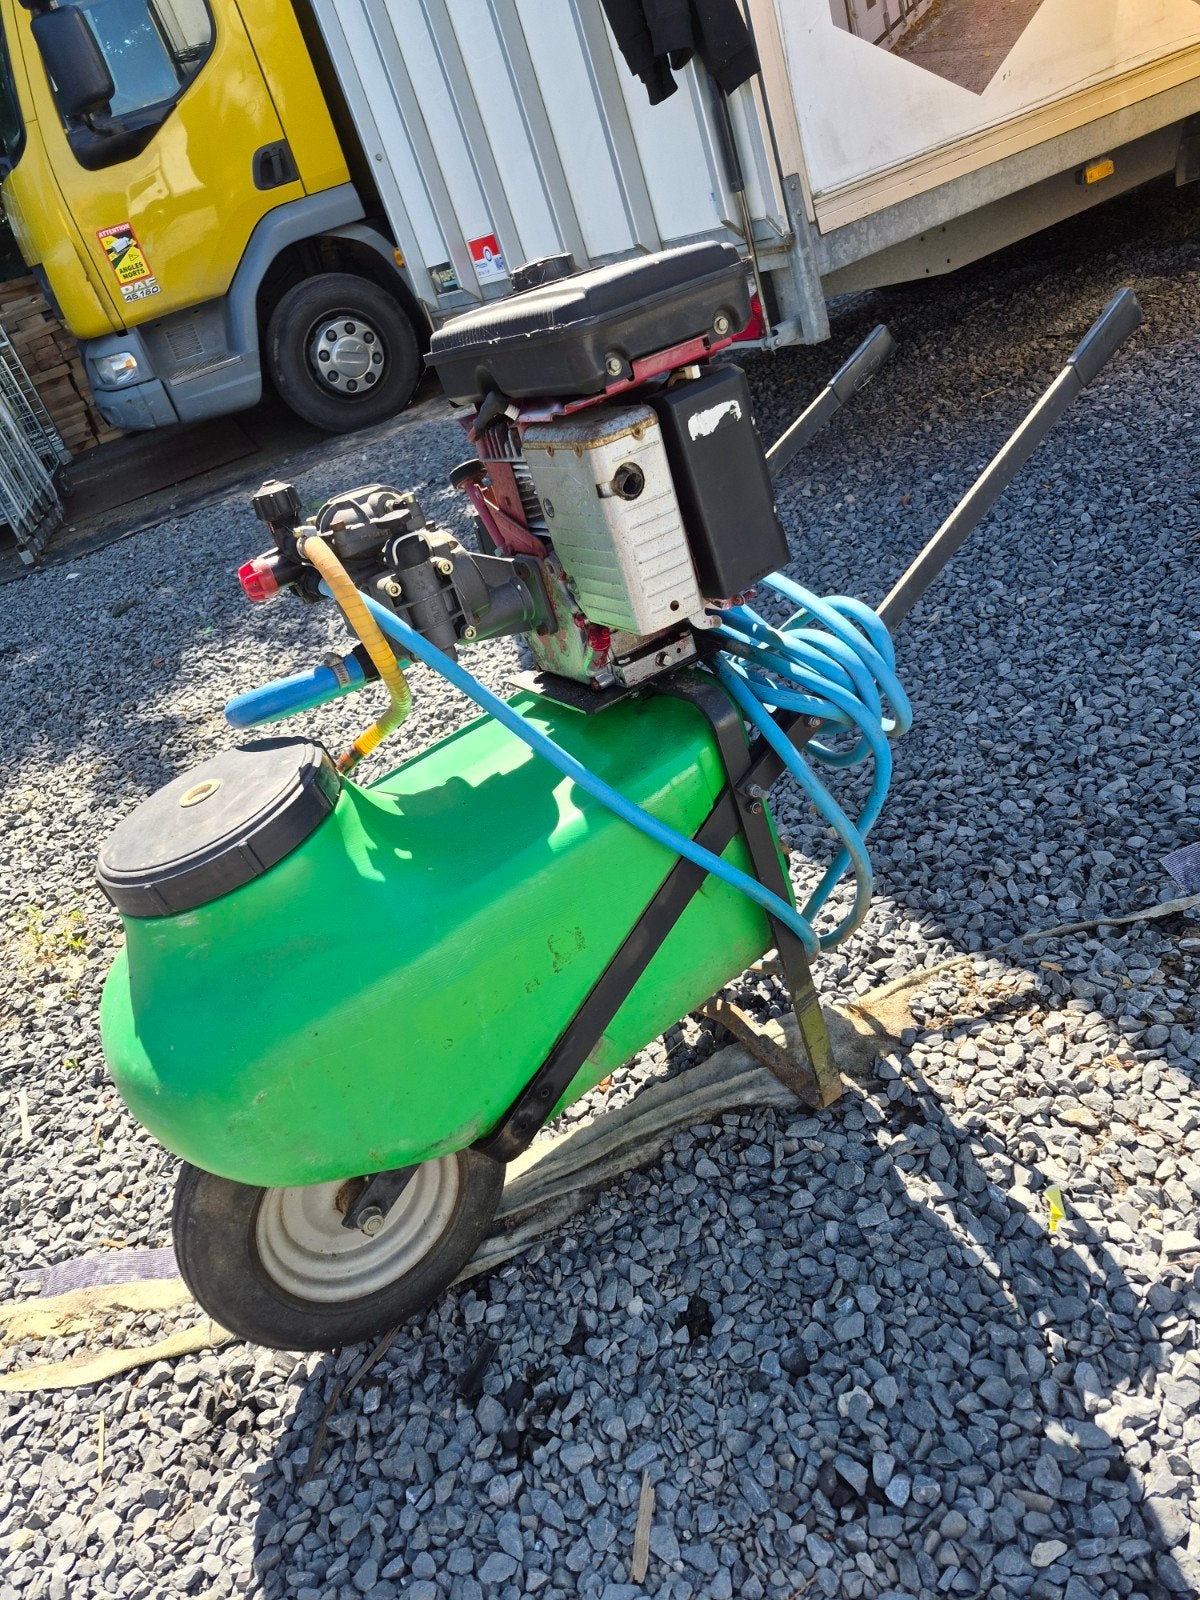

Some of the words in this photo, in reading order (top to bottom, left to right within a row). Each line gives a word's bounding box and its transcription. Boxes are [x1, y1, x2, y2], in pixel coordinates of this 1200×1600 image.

[98, 223, 131, 238] ATTENTION
[119, 261, 143, 274] ANGLES
[122, 268, 145, 280] MORTS
[120, 277, 157, 295] DAF
